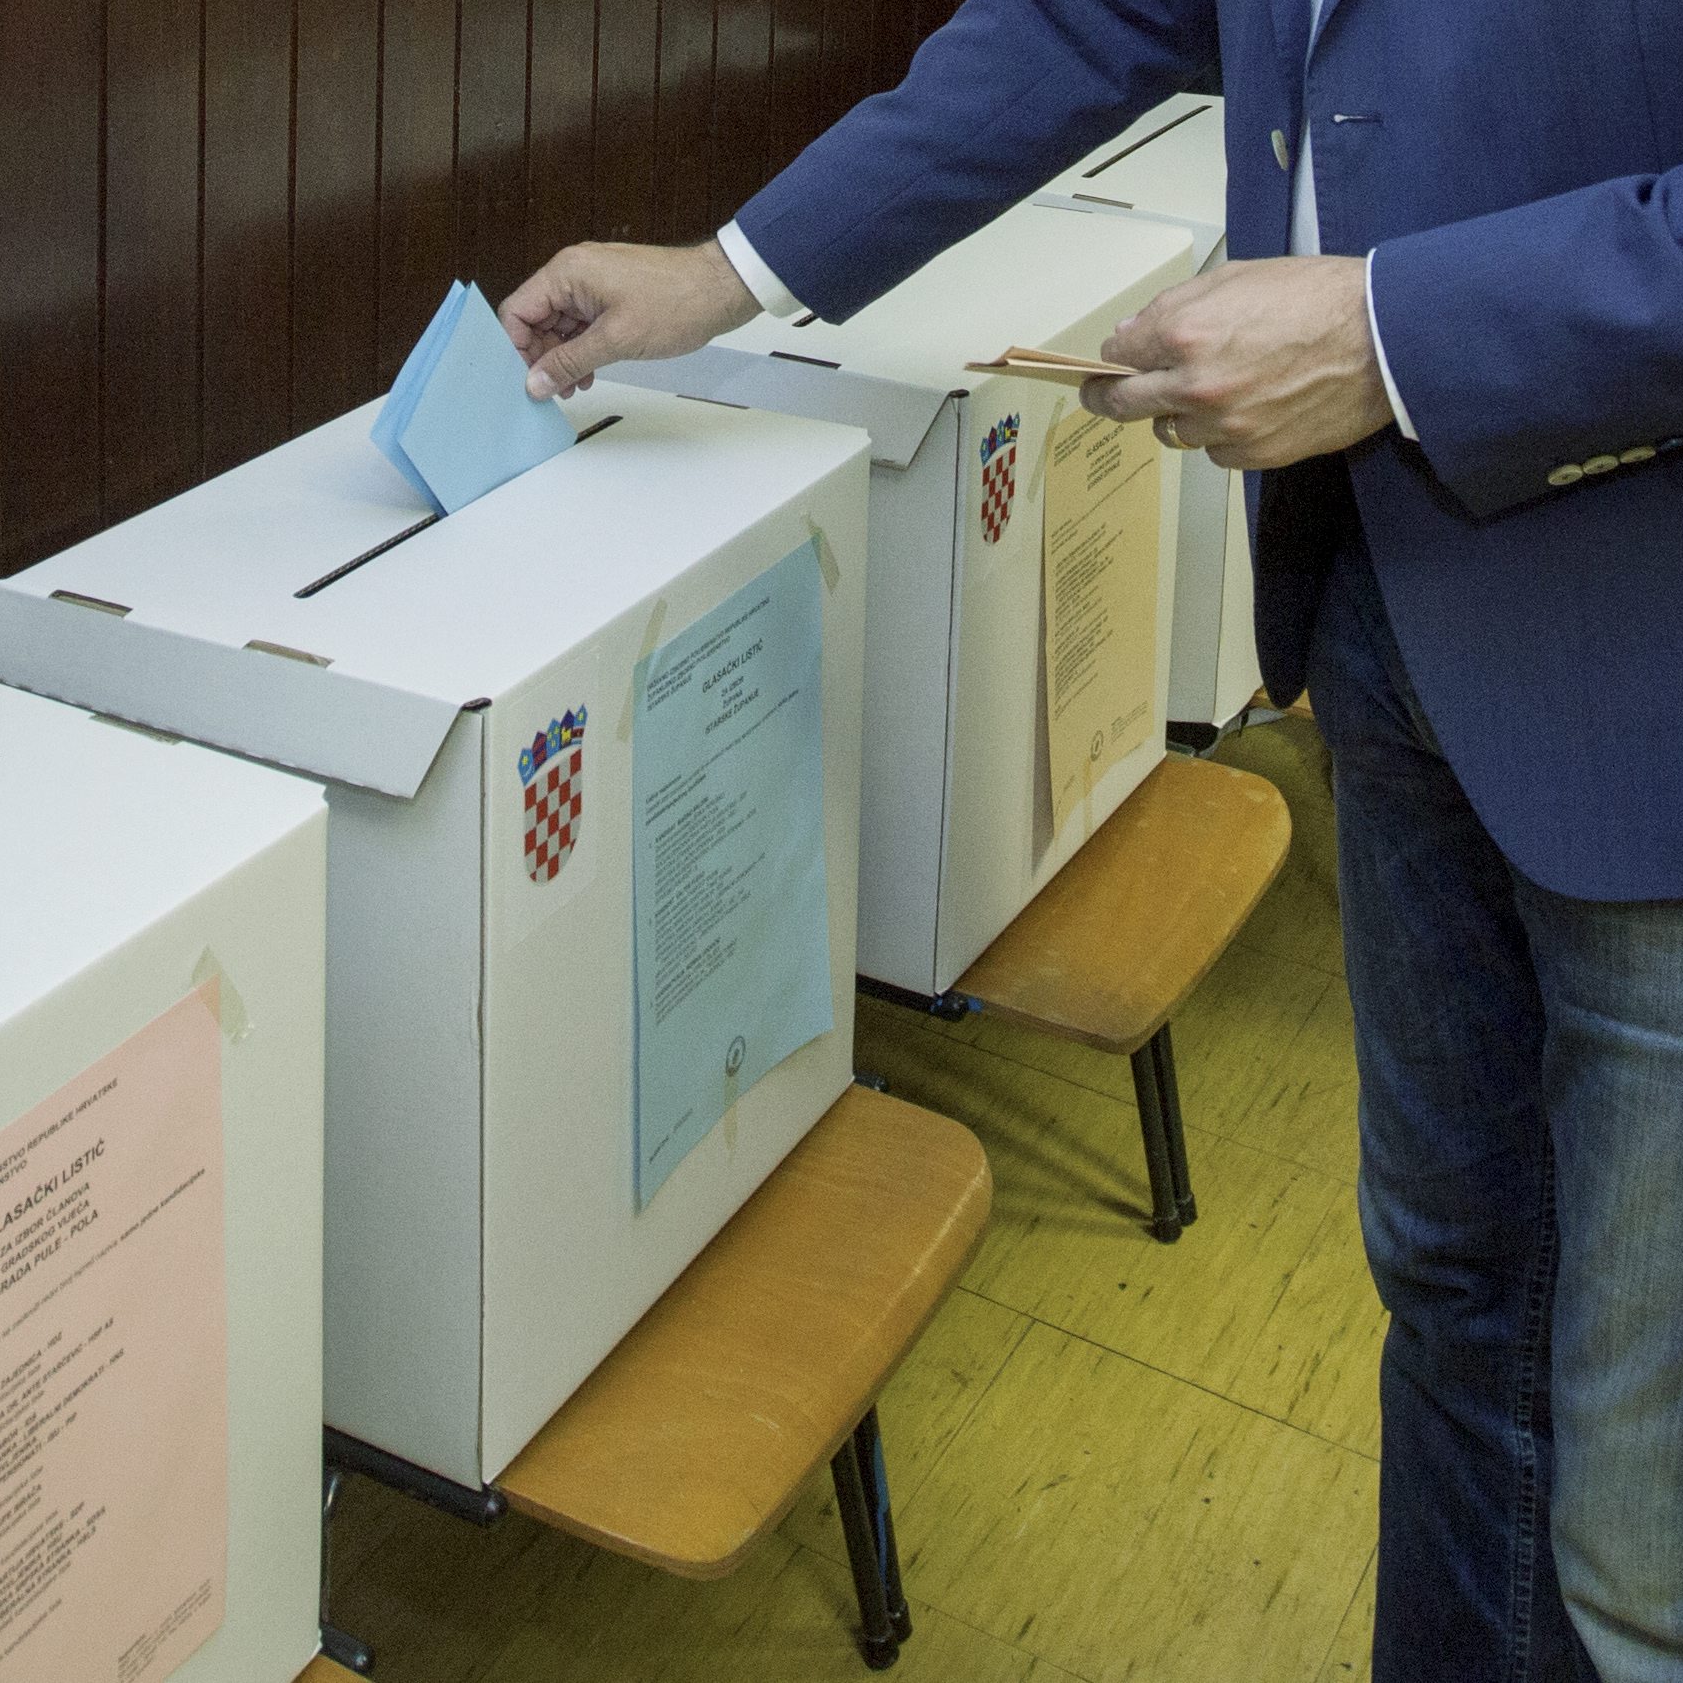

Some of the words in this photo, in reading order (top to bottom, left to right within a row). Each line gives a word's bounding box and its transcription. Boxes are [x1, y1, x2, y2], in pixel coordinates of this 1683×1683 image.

[701, 656, 740, 694] GLASAČKI
[740, 636, 763, 664] LISTIĆ
[26, 1110, 73, 1151] REPUBLIKE
[75, 1076, 118, 1114] HRVATSKE
[61, 1135, 105, 1183] LISTIĆ
[0, 1240, 12, 1257] ZA
[14, 1215, 44, 1246] IZBOR
[45, 1179, 90, 1221] ČLANOVA
[0, 1224, 54, 1274] GRADSKOG
[56, 1196, 90, 1229] VIJEĆA
[33, 1236, 61, 1268] PULE
[69, 1206, 98, 1238] POLA
